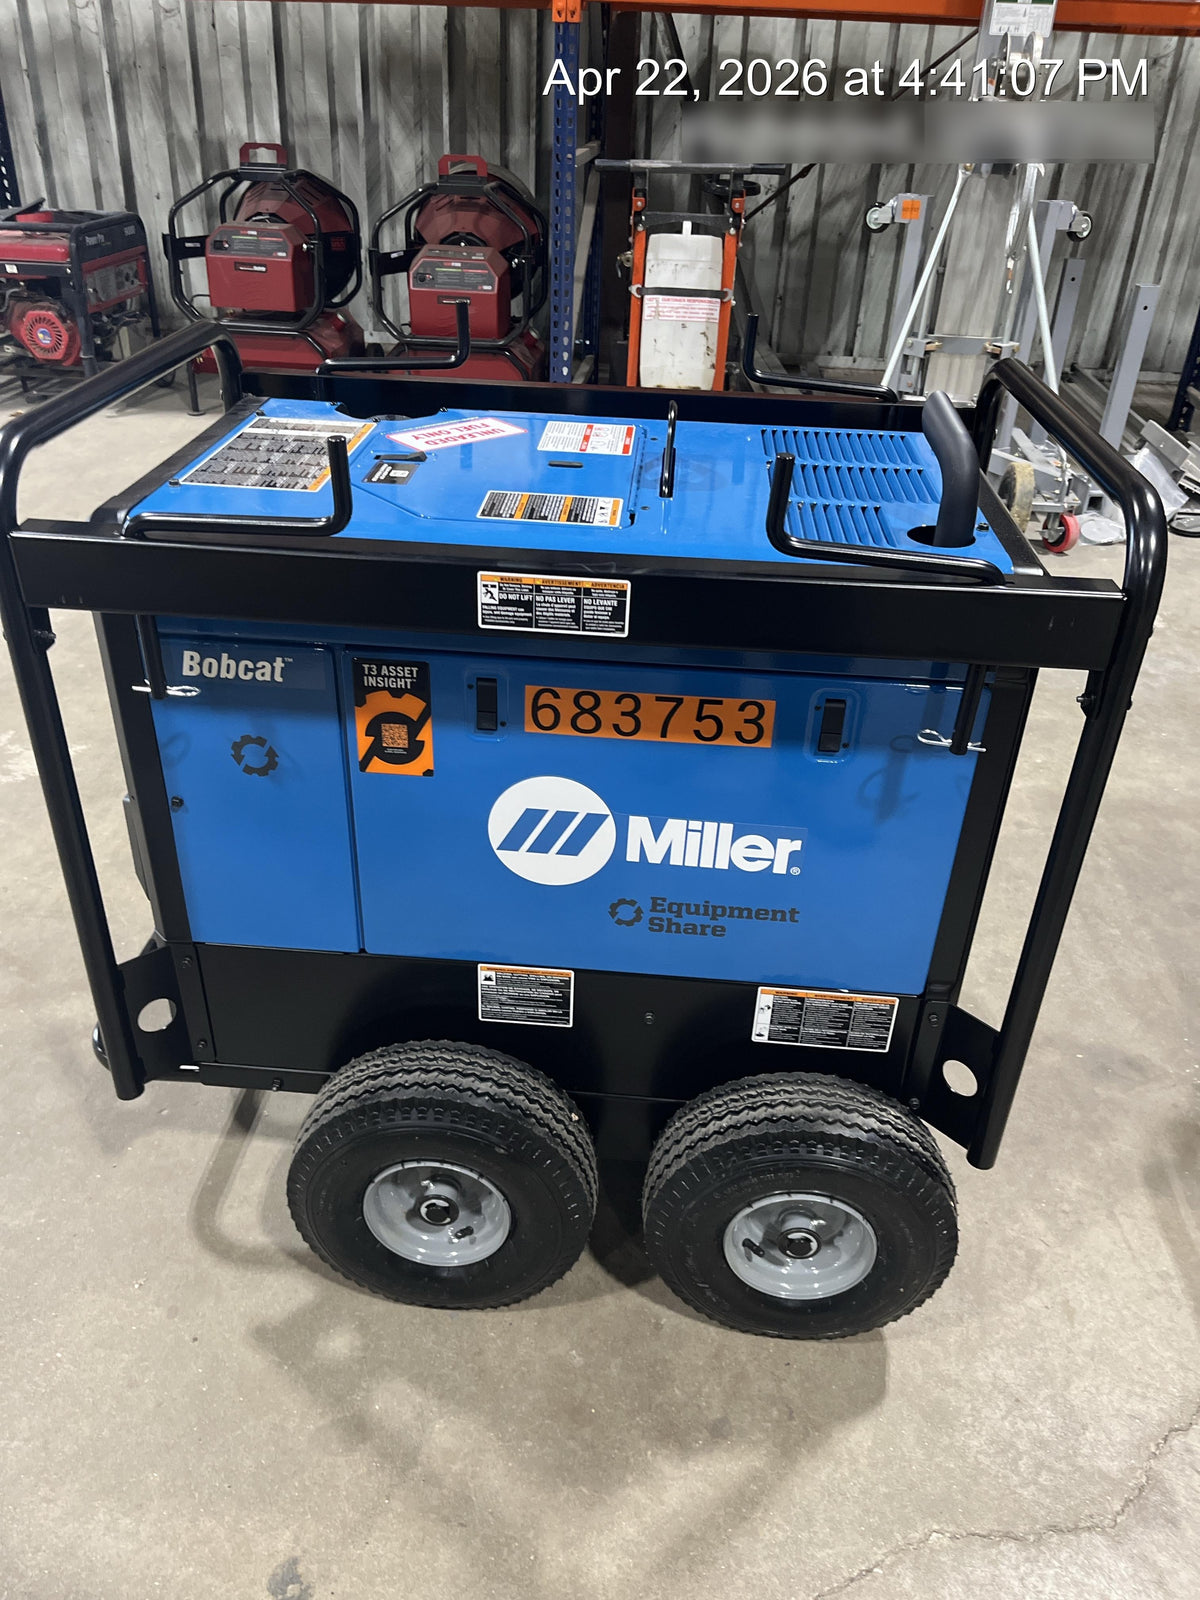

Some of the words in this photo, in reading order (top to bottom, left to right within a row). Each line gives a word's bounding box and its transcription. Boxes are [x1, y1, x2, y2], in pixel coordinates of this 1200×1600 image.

[450, 422, 490, 433] FUEL
[411, 429, 451, 441] ONLY
[424, 428, 506, 446] UNLEADED
[591, 582, 625, 590] ADVERTENCIA
[520, 594, 533, 602] LIFT
[593, 599, 618, 607] LEVANTE
[362, 664, 378, 675] T3
[381, 665, 419, 678] ASSET
[531, 687, 766, 745] 683753
[649, 897, 800, 923] Equipment
[648, 916, 727, 938] Share
